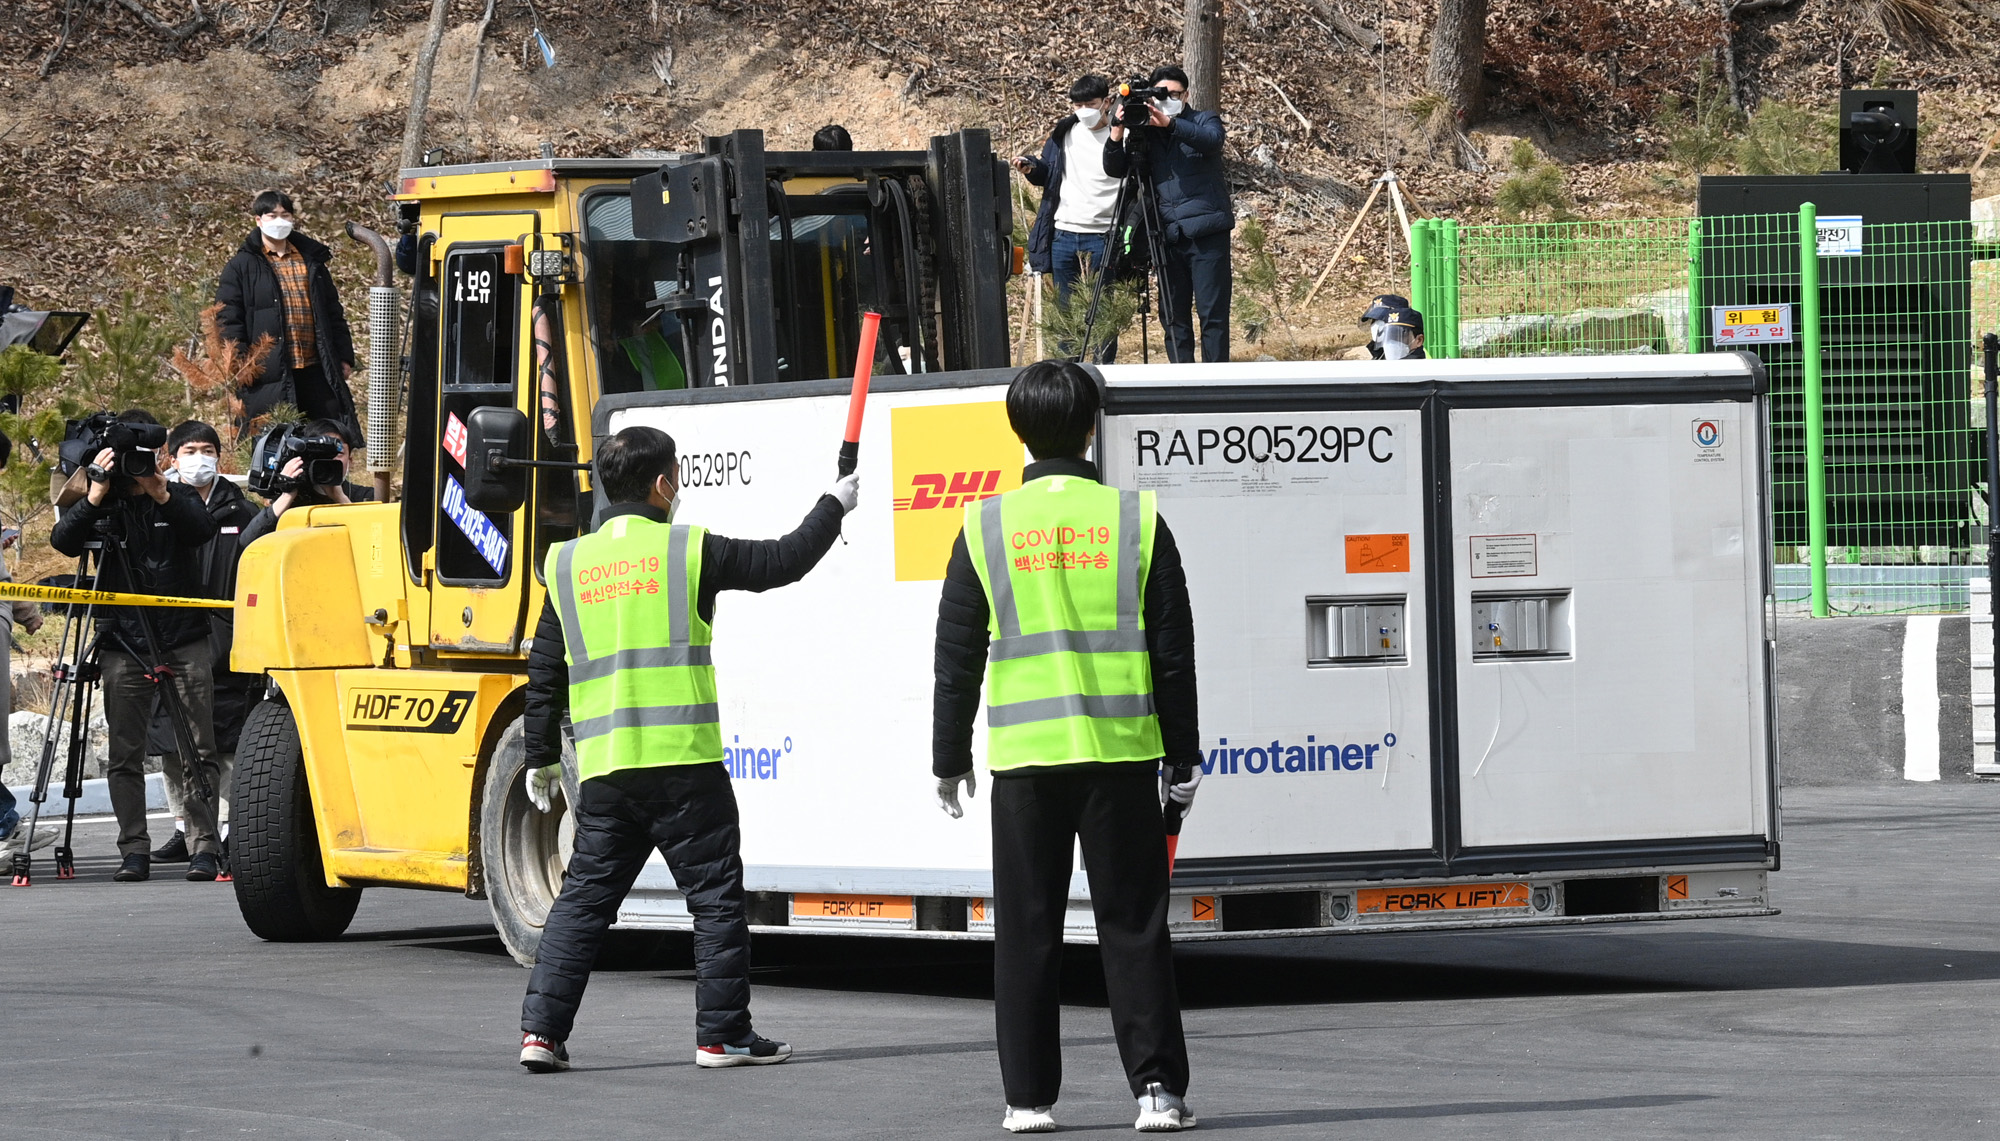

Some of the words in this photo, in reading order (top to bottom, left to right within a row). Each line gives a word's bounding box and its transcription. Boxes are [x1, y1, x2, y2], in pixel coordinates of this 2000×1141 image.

[1137, 425, 1394, 467] RAP80529PC
[442, 477, 509, 573] 010-2025-4847
[1011, 526, 1111, 550] COVID-19
[578, 556, 660, 585] COVID-19
[1014, 550, 1110, 573] 백신안전수송
[580, 578, 660, 605] 백신안전수송
[823, 900, 855, 916] FORK
[859, 901, 885, 917] LIFT
[1385, 892, 1447, 911] FORK
[1456, 890, 1502, 908] LIFT
